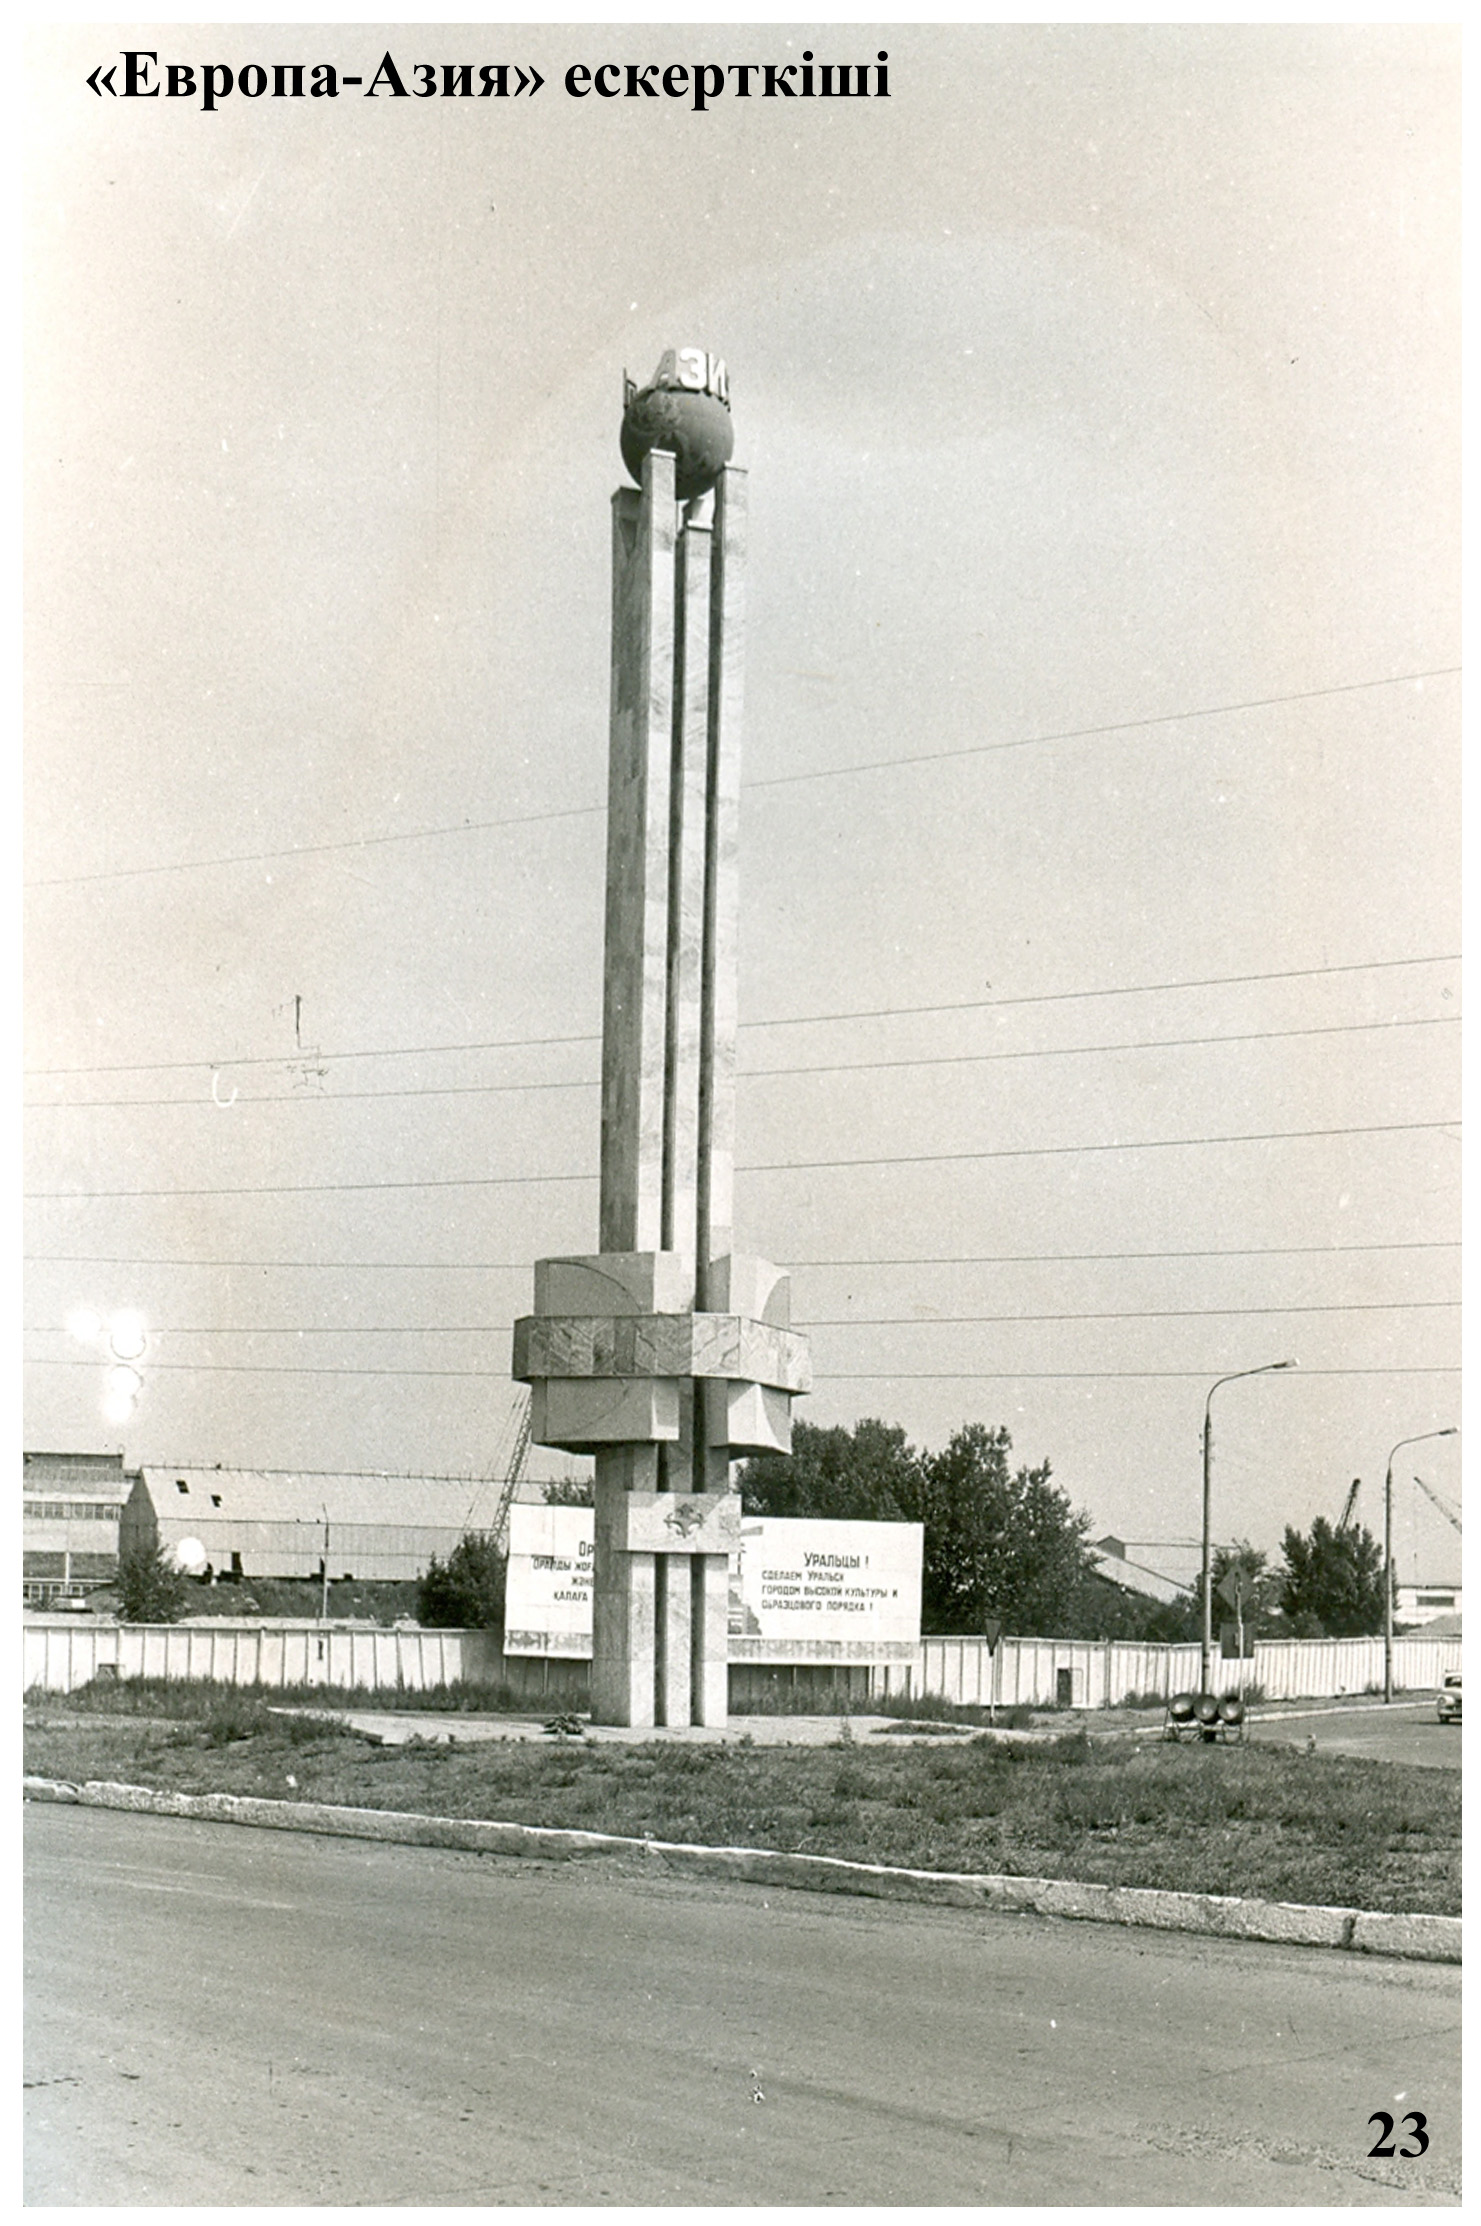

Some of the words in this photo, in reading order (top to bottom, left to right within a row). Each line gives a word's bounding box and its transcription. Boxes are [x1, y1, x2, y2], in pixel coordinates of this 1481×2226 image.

[650, 348, 731, 411] АЗИ
[803, 1552, 860, 1569] УРАЛЬЦЫ
[761, 1570, 802, 1581] СДЕЛАЕМ
[807, 1570, 844, 1582] УРАЛЬСК
[761, 1585, 801, 1596] ГОРОДОМ
[804, 1585, 843, 1597] ВЫСОКОЙ
[844, 1587, 888, 1598] КУЛЬТУРЫ
[892, 1588, 898, 1598] И
[761, 1599, 822, 1611] ОБРАЗЦОВОГО
[826, 1600, 866, 1612] ПОРЯДКА
